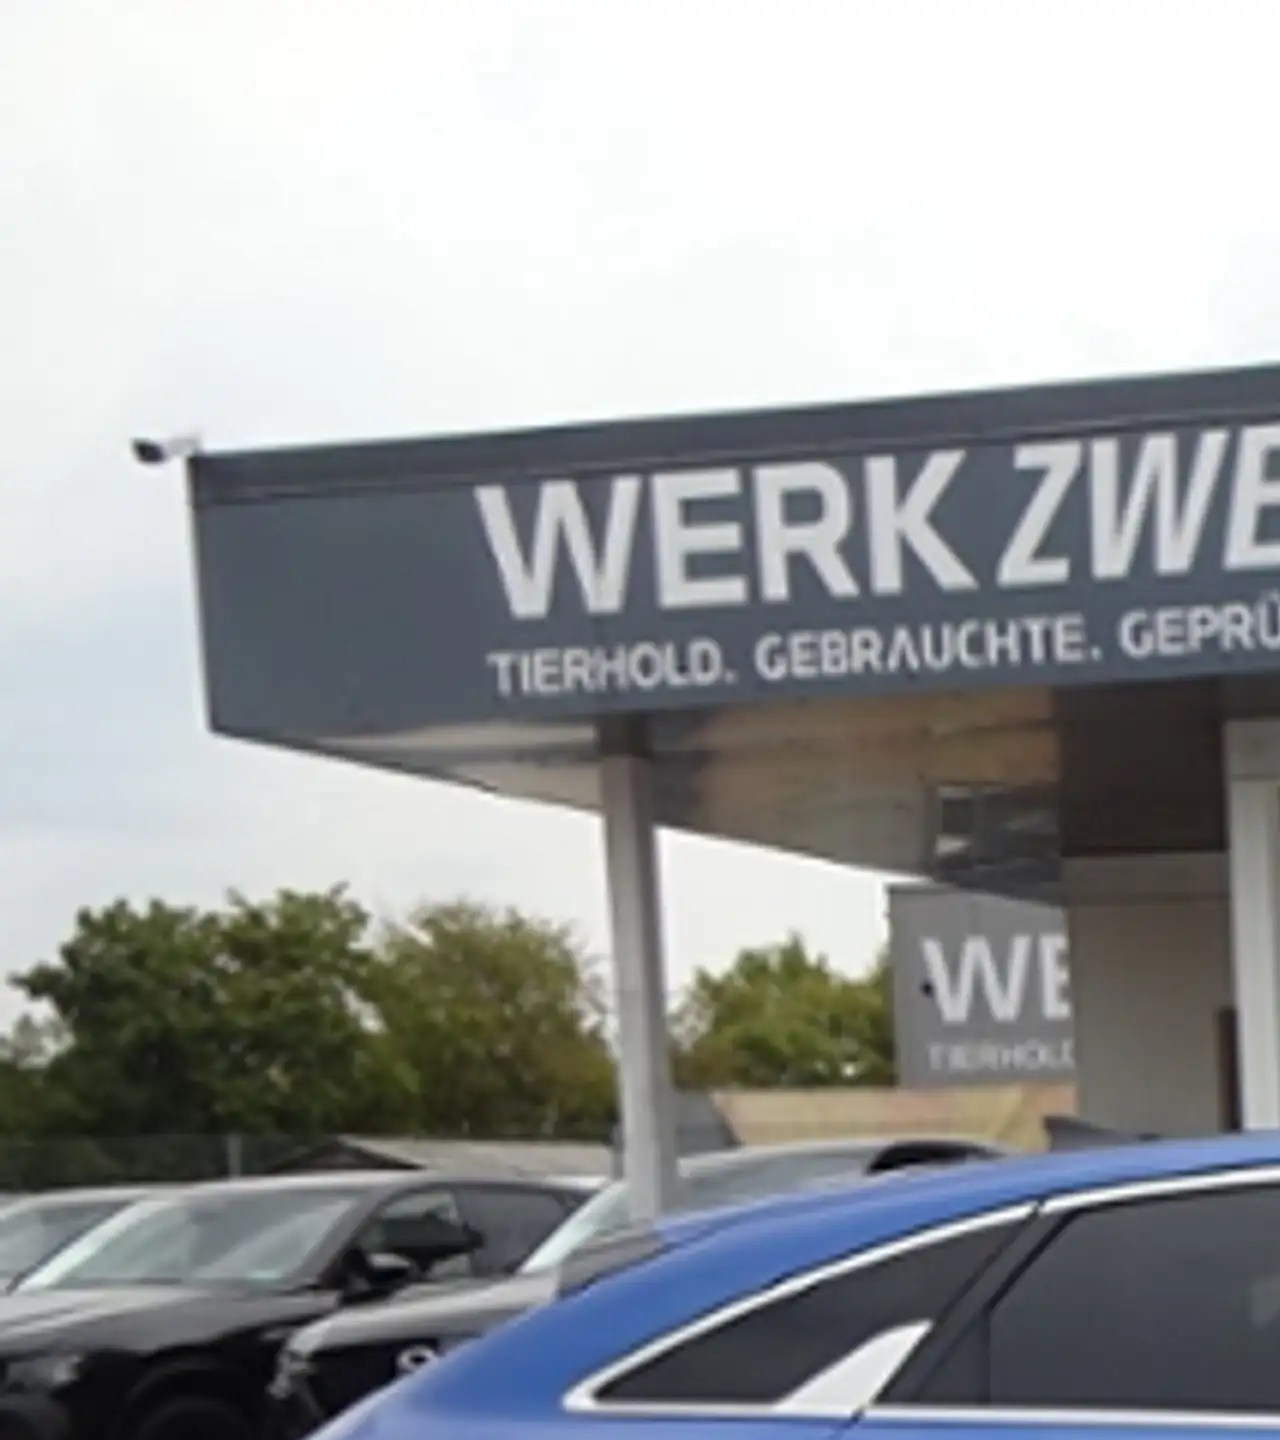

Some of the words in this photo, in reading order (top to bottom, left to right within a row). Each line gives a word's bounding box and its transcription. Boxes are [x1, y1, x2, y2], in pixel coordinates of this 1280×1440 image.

[474, 447, 979, 621] WERK
[486, 636, 739, 697] TIERHOLD.
[753, 609, 1103, 682] GEBRAUCHTE.
